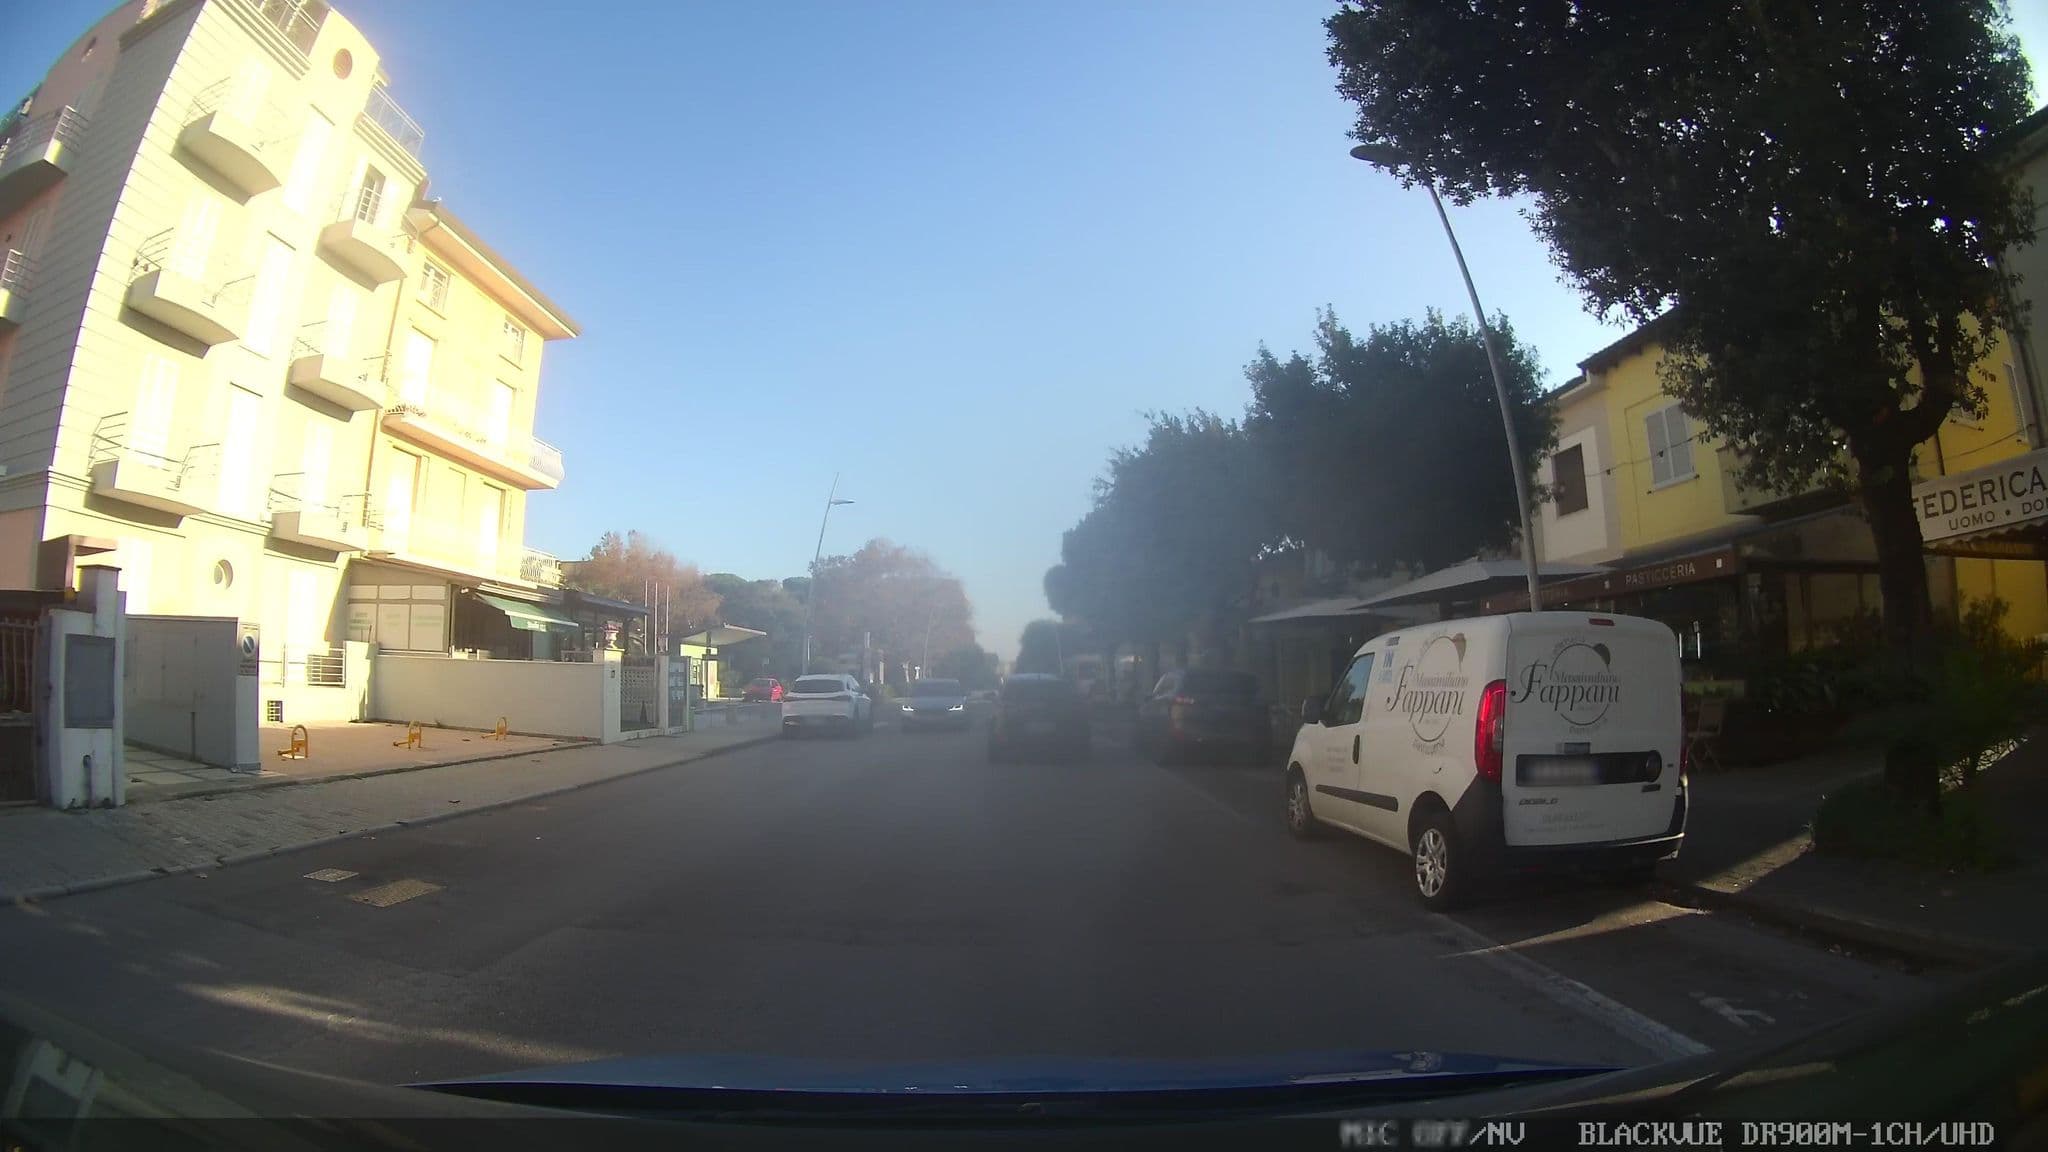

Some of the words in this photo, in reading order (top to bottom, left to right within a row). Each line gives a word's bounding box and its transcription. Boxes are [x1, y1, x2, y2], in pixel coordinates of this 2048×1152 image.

[1948, 511, 1996, 530] UOMO
[2022, 499, 2048, 515] DO
[1625, 562, 1697, 585] PASTICCERIA
[1385, 659, 1465, 724] Fappani
[1510, 659, 1620, 711] Fappani
